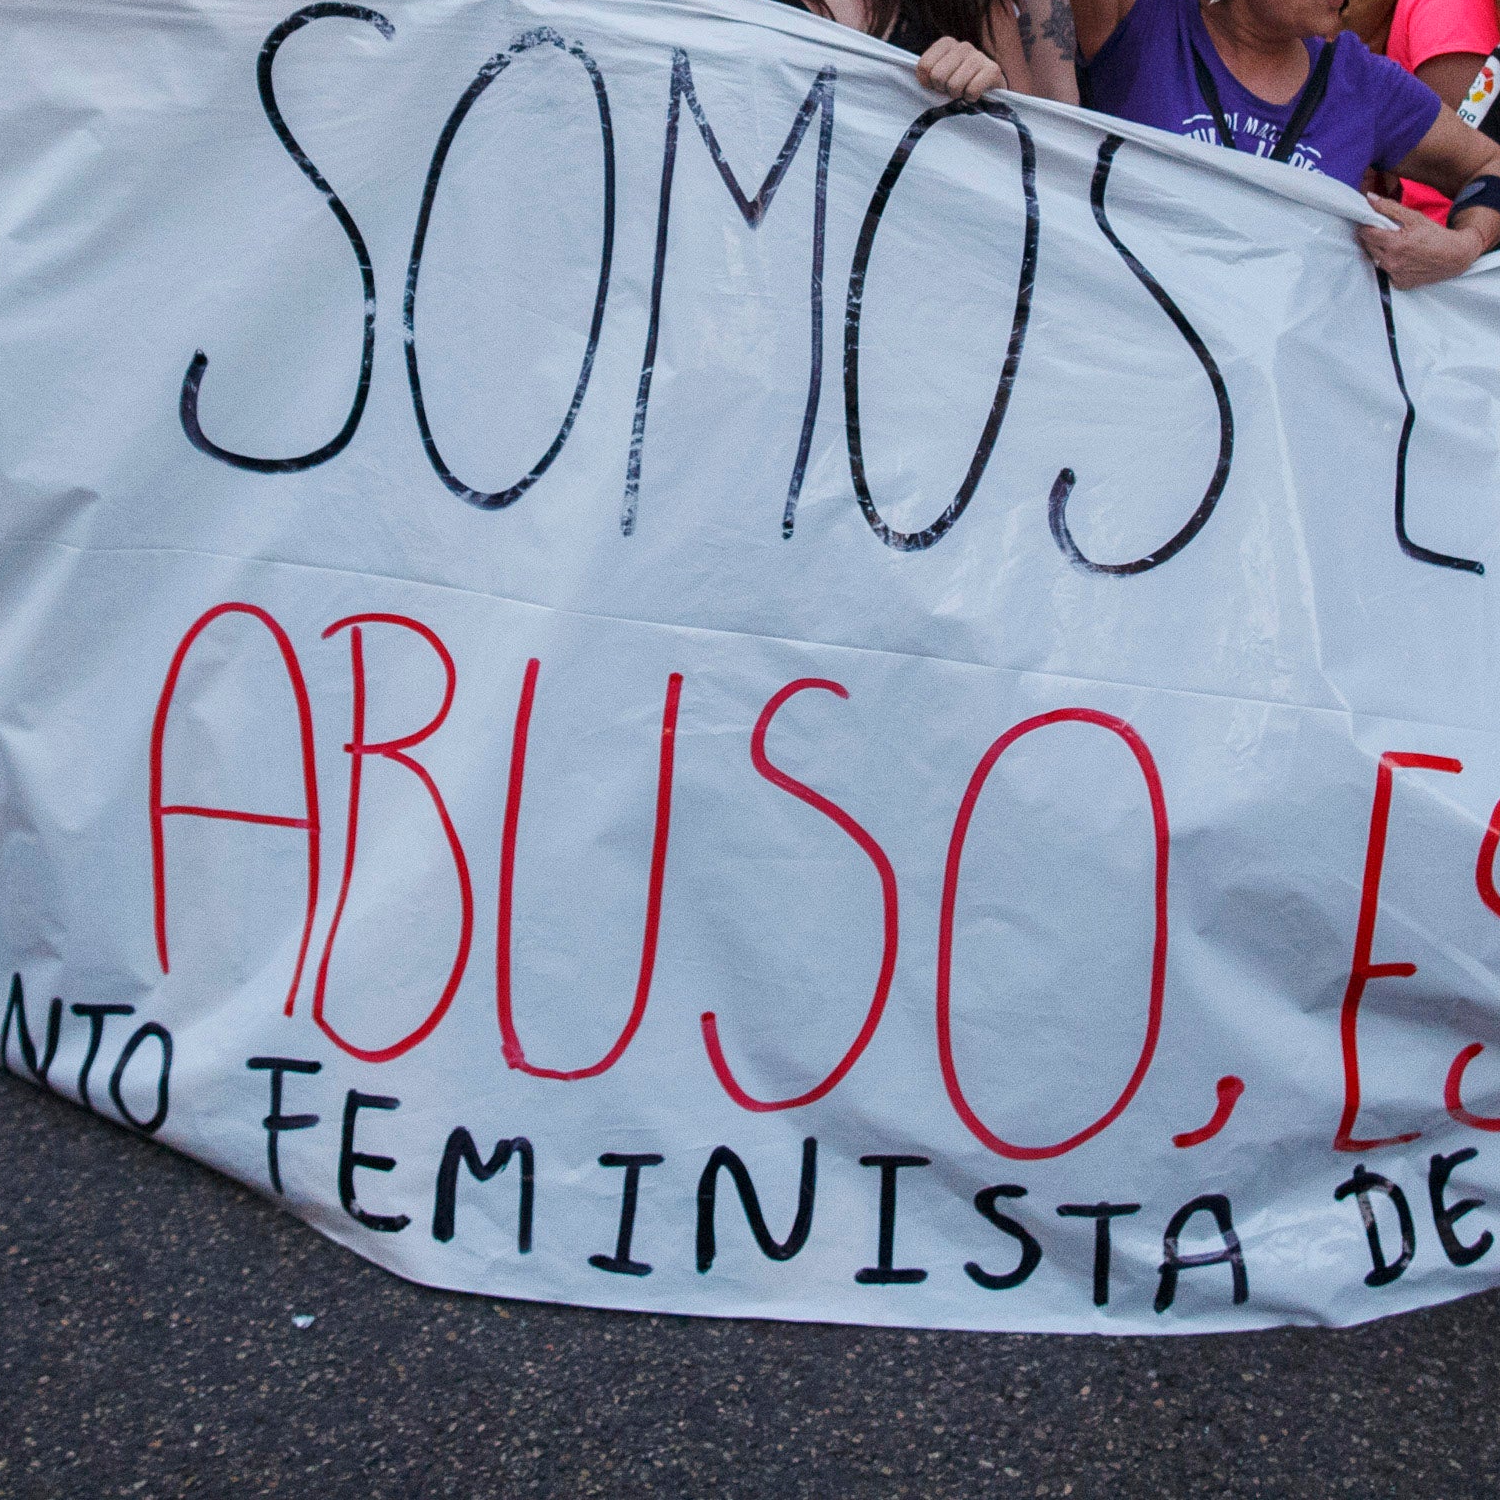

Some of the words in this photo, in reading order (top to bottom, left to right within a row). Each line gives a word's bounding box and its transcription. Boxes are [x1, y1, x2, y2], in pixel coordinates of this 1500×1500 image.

[179, 1, 1235, 578] SOMOS
[148, 601, 1246, 1160] ABUSO,
[245, 1055, 1249, 1312] FEMINISTA
[1335, 1146, 1496, 1288] DE
